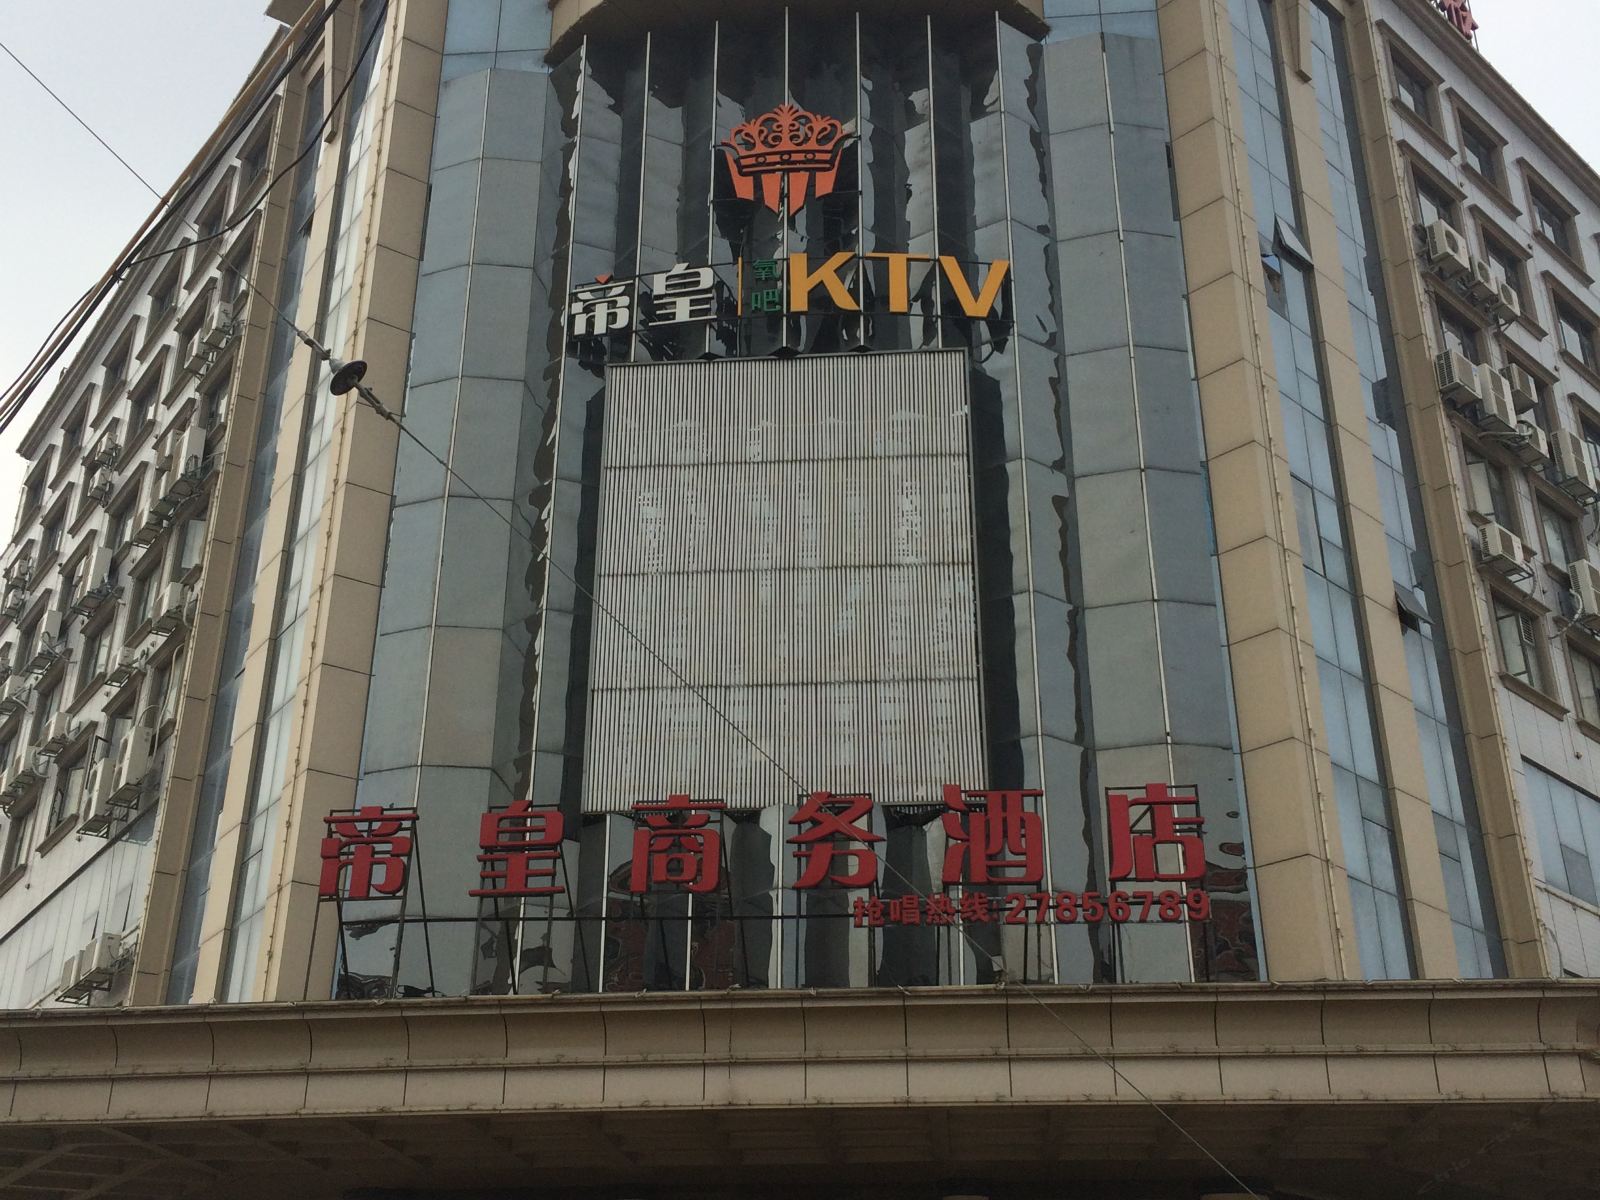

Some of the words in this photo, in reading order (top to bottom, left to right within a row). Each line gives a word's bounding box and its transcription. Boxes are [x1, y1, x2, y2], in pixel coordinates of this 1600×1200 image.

[570, 262, 718, 336] 帝皇
[752, 258, 781, 312] 氧吧
[789, 252, 1010, 318] KTV
[319, 783, 1207, 900] 帝皇商务酒店
